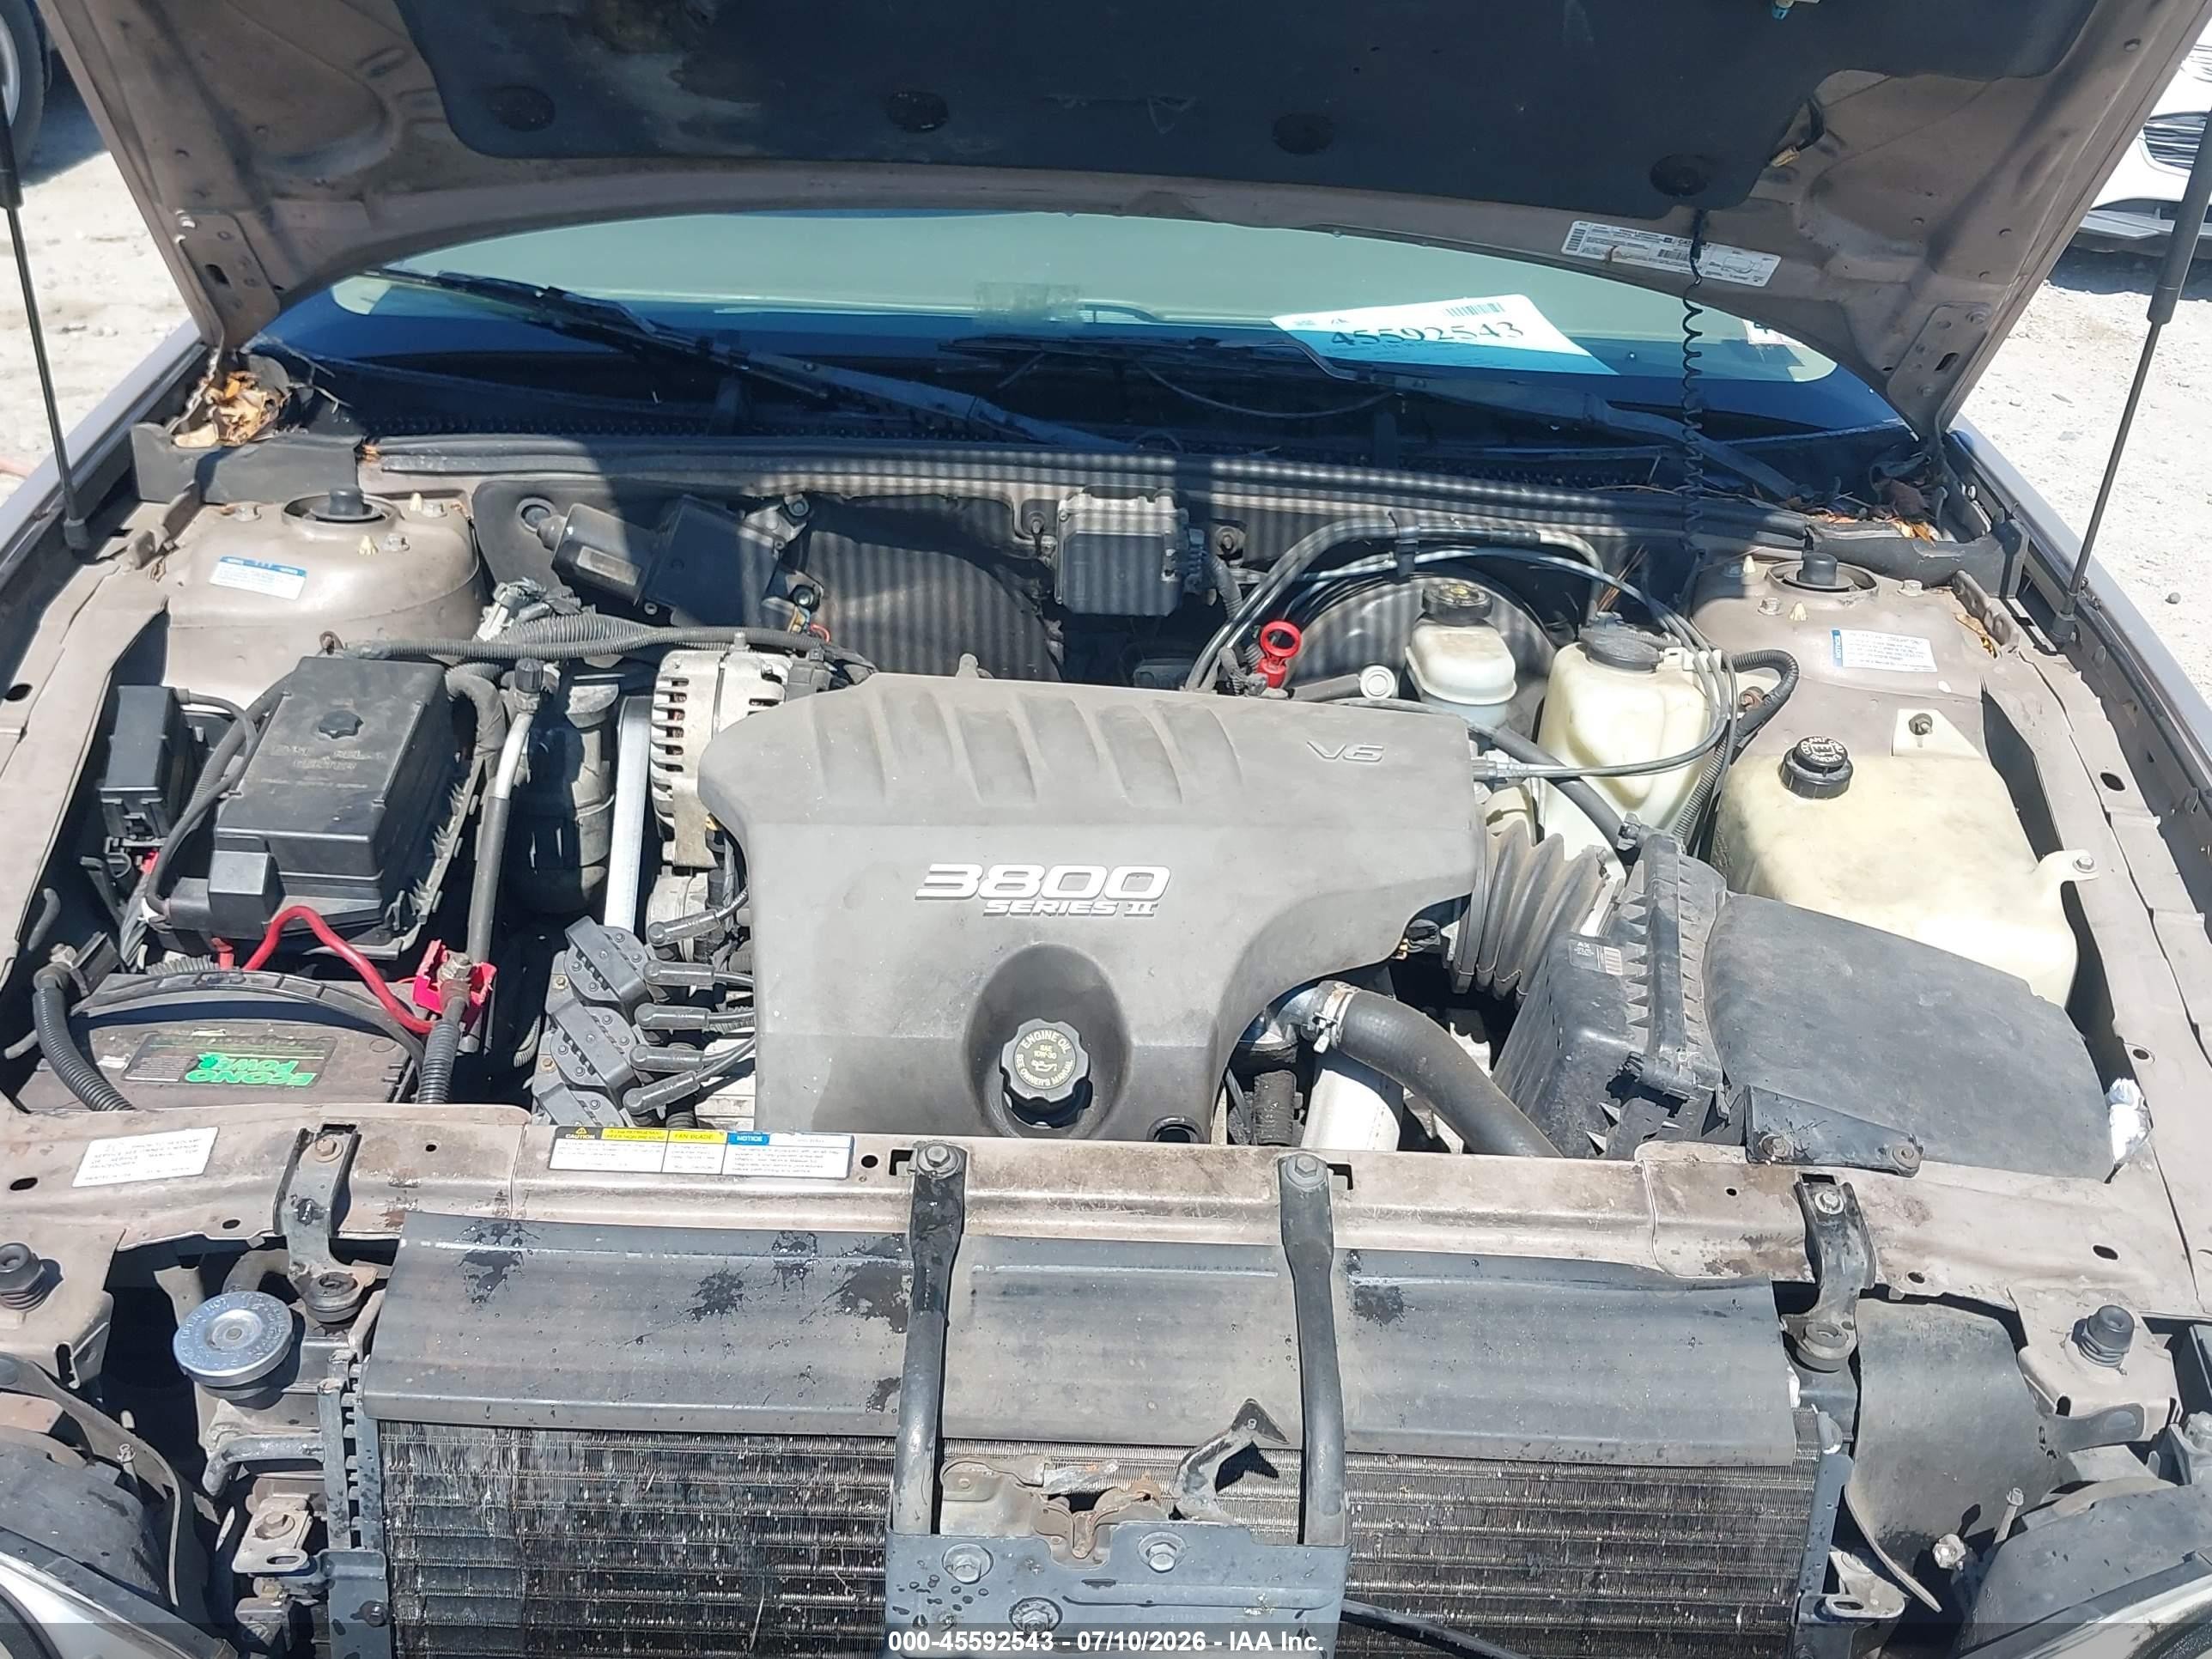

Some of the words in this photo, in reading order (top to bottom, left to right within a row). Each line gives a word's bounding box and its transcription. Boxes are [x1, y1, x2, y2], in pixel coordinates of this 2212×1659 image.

[1331, 321, 1523, 346] 45592543
[1306, 740, 1384, 765] V6
[914, 862, 1171, 901] 3800
[982, 900, 1119, 917] SERIES
[1020, 1030, 1060, 1048] ENGINE
[1057, 1038, 1071, 1054] OIL
[198, 1054, 300, 1073] POWER
[1016, 1054, 1025, 1068] SEE
[1051, 1059, 1073, 1085] MANUAL
[185, 1070, 318, 1086] ECONO
